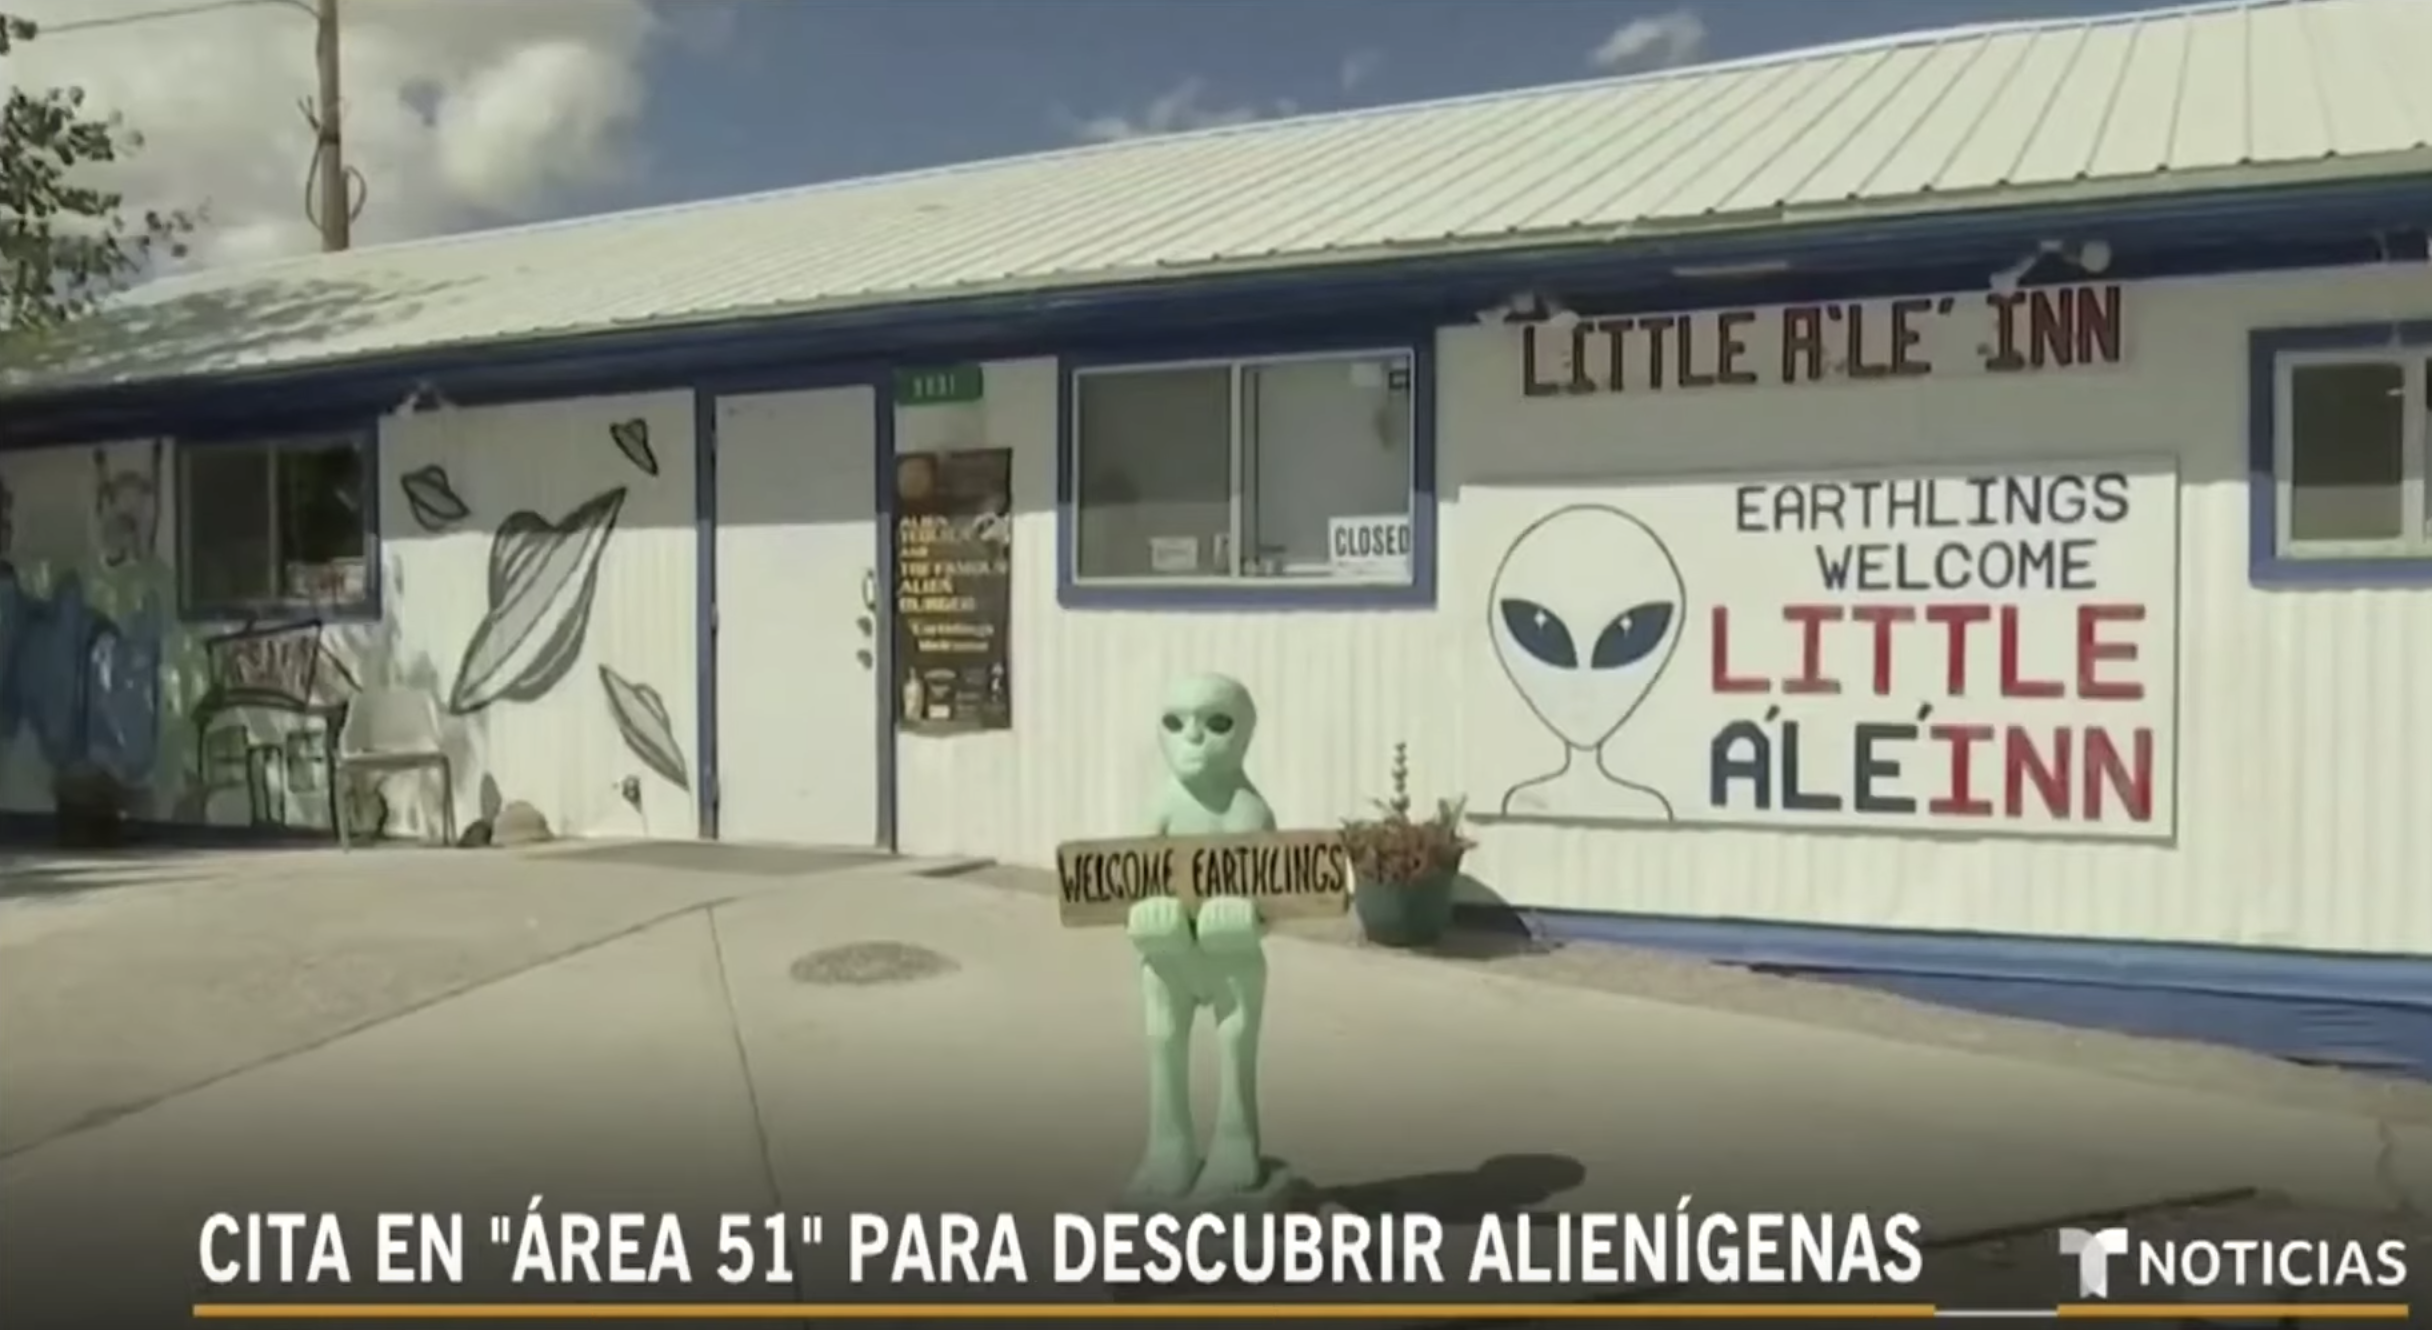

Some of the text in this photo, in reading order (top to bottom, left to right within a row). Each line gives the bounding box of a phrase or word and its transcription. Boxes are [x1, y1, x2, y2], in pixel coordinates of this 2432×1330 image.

[1523, 311, 1757, 396] LITTLE
[1986, 285, 2121, 372] INN
[1736, 472, 2130, 531] EARTHLINGS
[1334, 524, 1410, 558] CLOSED
[1815, 538, 2097, 591] WELCOME
[1711, 604, 2145, 700] LITTLE
[1058, 843, 1345, 903] WELCOME EARTHLINGS
